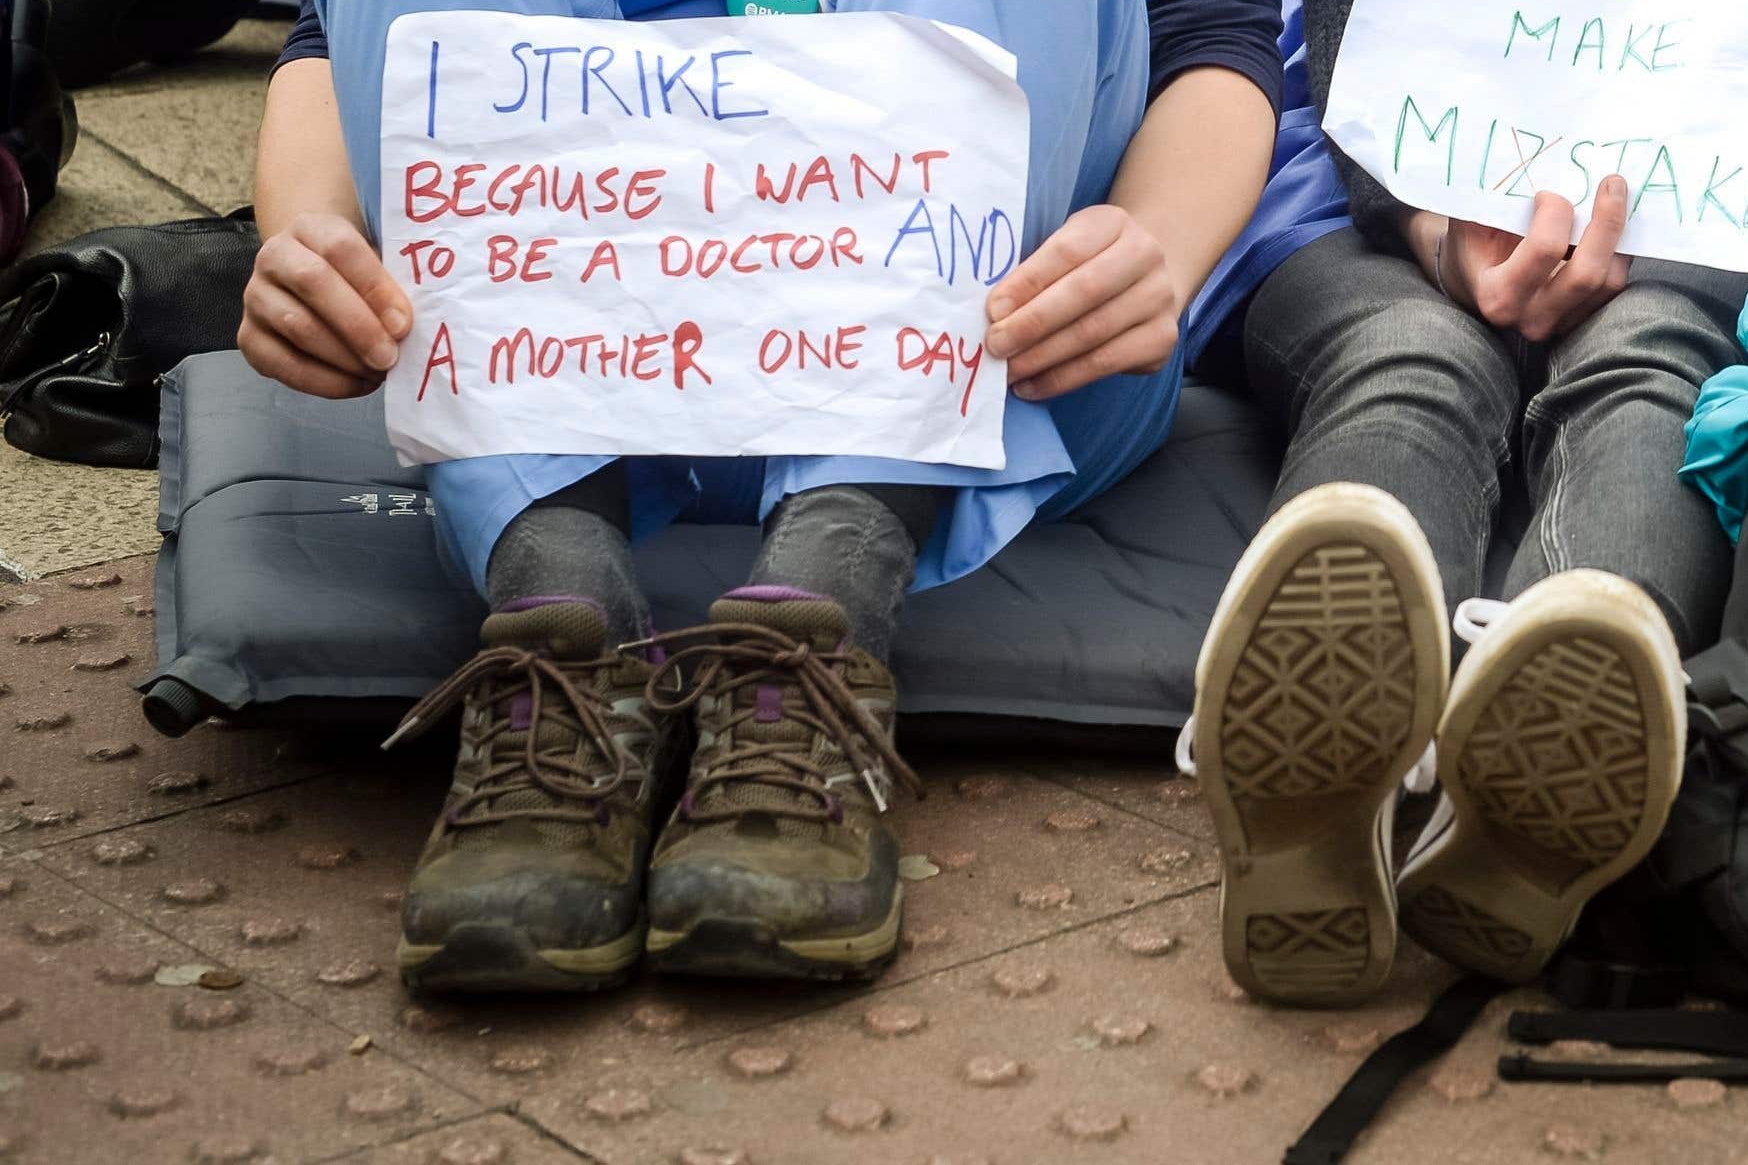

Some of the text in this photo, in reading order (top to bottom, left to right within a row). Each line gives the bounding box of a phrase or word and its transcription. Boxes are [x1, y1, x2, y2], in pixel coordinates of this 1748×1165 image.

[1503, 10, 1692, 73] MAKE
[426, 40, 769, 139] I STRIKE
[404, 150, 950, 224] BECAUSE I WANT
[400, 198, 1017, 287] TO BE A DOCTOR AND
[418, 320, 985, 417] A MOTHER ONE DAY
